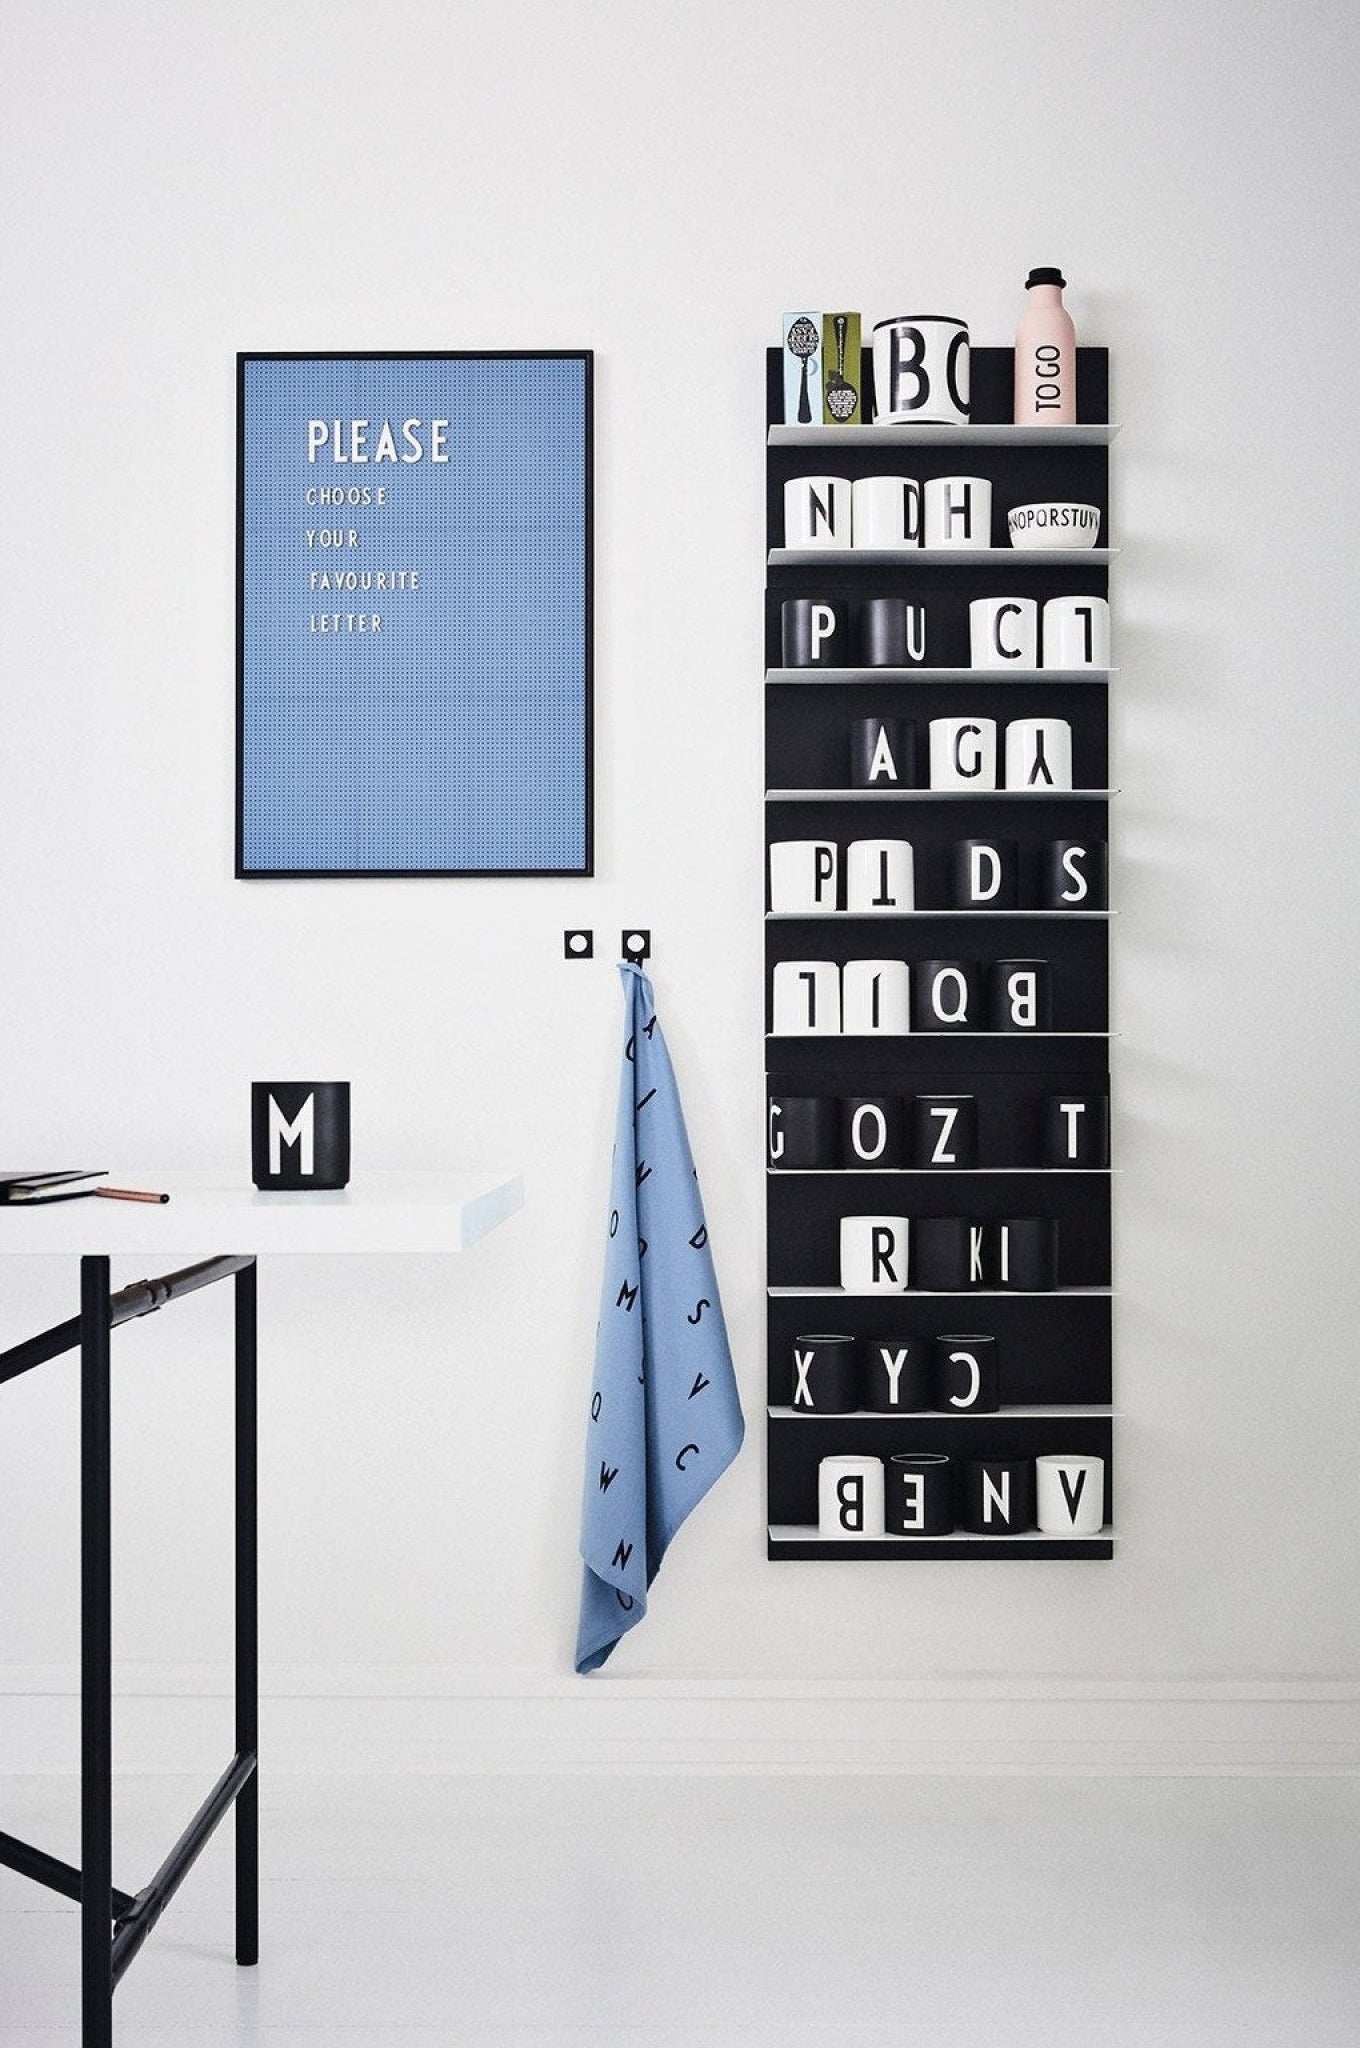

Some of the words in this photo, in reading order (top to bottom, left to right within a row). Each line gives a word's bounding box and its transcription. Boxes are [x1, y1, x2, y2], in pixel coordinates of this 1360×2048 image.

[1035, 345, 1061, 379] GO
[1035, 384, 1061, 412] TO
[306, 419, 451, 464] PLEASE
[306, 487, 387, 505] CHOOSE
[809, 484, 835, 537] N
[944, 484, 971, 539] H
[306, 530, 359, 548] YOUR
[310, 572, 421, 590] FAVOURITE
[310, 614, 383, 633] LETTER
[812, 605, 836, 659] P
[907, 605, 925, 661] U
[996, 604, 1022, 659] C
[868, 726, 898, 780] A
[955, 725, 982, 778] G
[815, 848, 833, 902] P
[971, 846, 1001, 901] D
[1060, 847, 1088, 902] S
[932, 968, 968, 1023] Q
[1007, 972, 1036, 1027] B
[269, 1093, 314, 1175] M
[852, 1104, 887, 1160] O
[930, 1108, 959, 1163] Z
[1060, 1104, 1085, 1158] T
[872, 1227, 898, 1283] R
[970, 1226, 983, 1281] K
[794, 1350, 815, 1406] X
[880, 1349, 908, 1404] Y
[836, 1475, 864, 1532] B
[904, 1473, 925, 1529] E
[983, 1468, 1010, 1525] N
[1058, 1469, 1087, 1524] V
